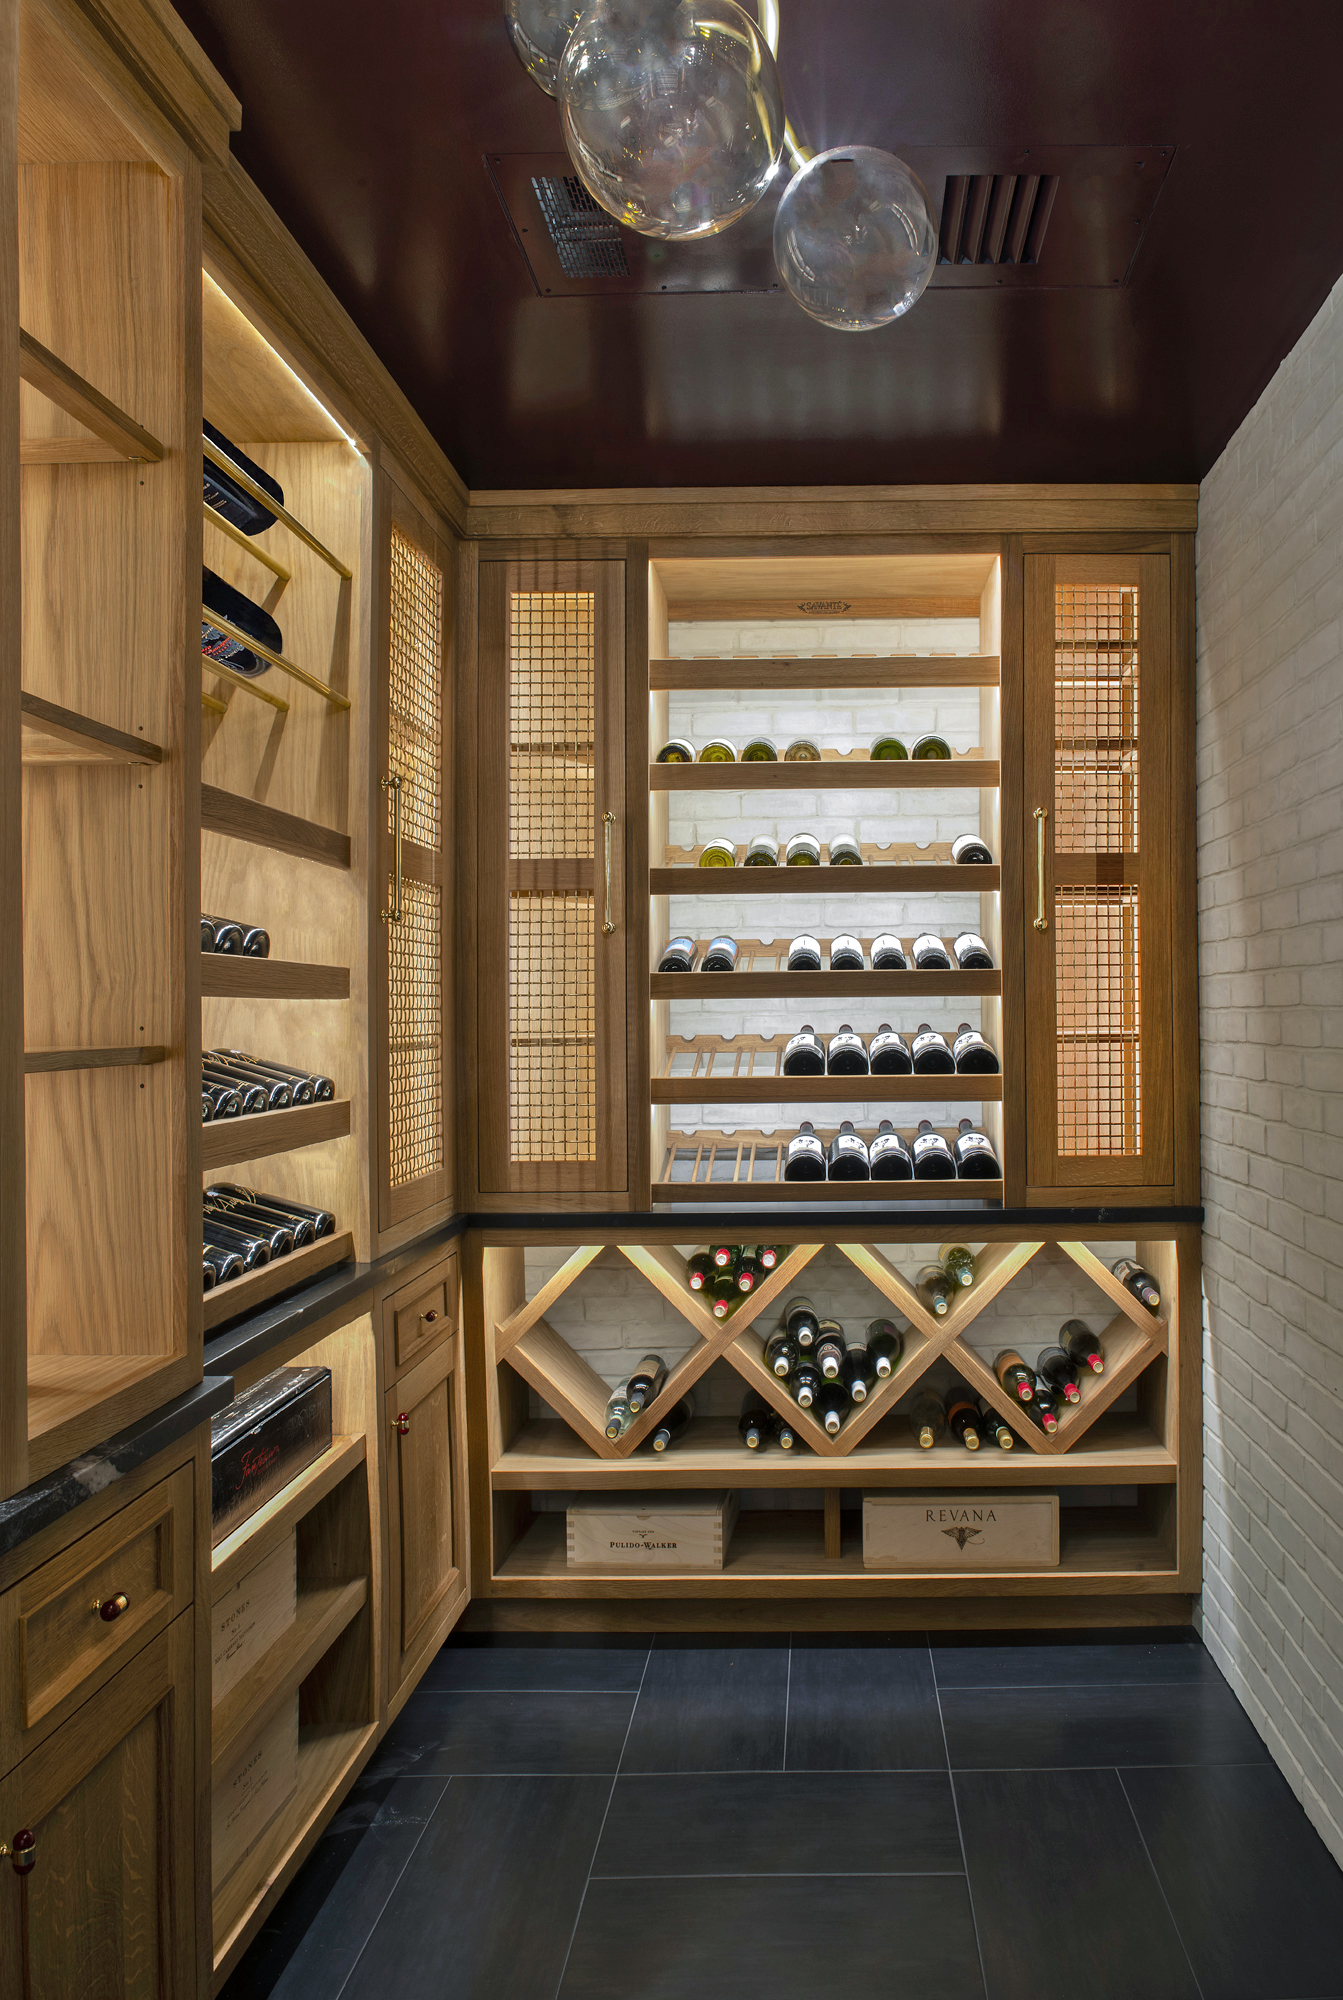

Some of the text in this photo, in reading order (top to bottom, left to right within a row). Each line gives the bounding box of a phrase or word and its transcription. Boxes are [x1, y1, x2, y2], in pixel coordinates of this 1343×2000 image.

[926, 1509, 997, 1522] REVANA
[609, 1541, 678, 1550] PULIDO-WALKER
[221, 1599, 250, 1632] STONES
[233, 1750, 262, 1789] STONES
